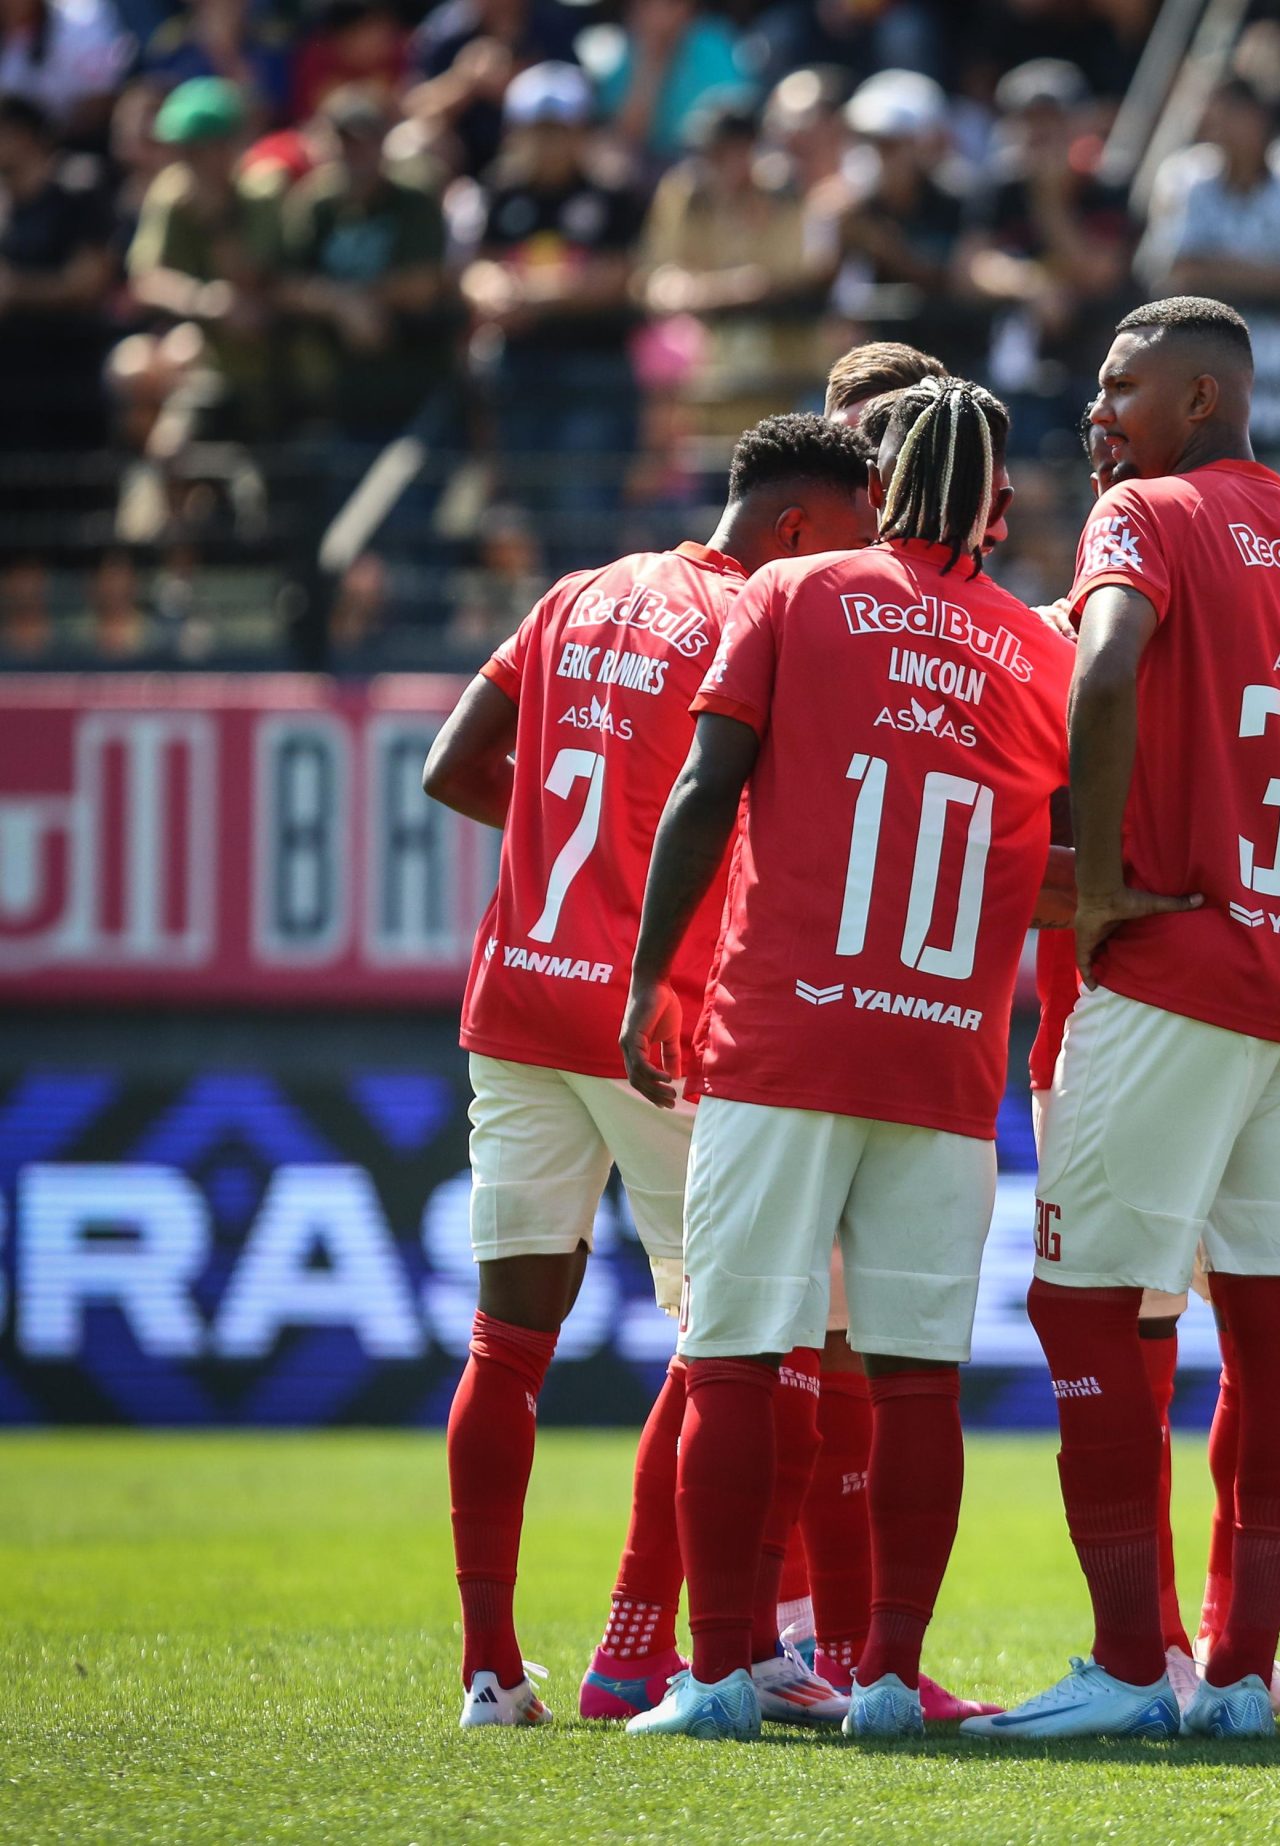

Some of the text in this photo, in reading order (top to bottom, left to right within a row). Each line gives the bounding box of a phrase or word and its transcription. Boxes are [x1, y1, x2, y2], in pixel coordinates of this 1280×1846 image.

[556, 642, 600, 681] ERIC
[889, 647, 987, 705] LINCOLN
[528, 748, 606, 944] 7
[835, 753, 995, 980] 10
[503, 946, 613, 984] YANMAR
[852, 987, 984, 1031] YANMAR
